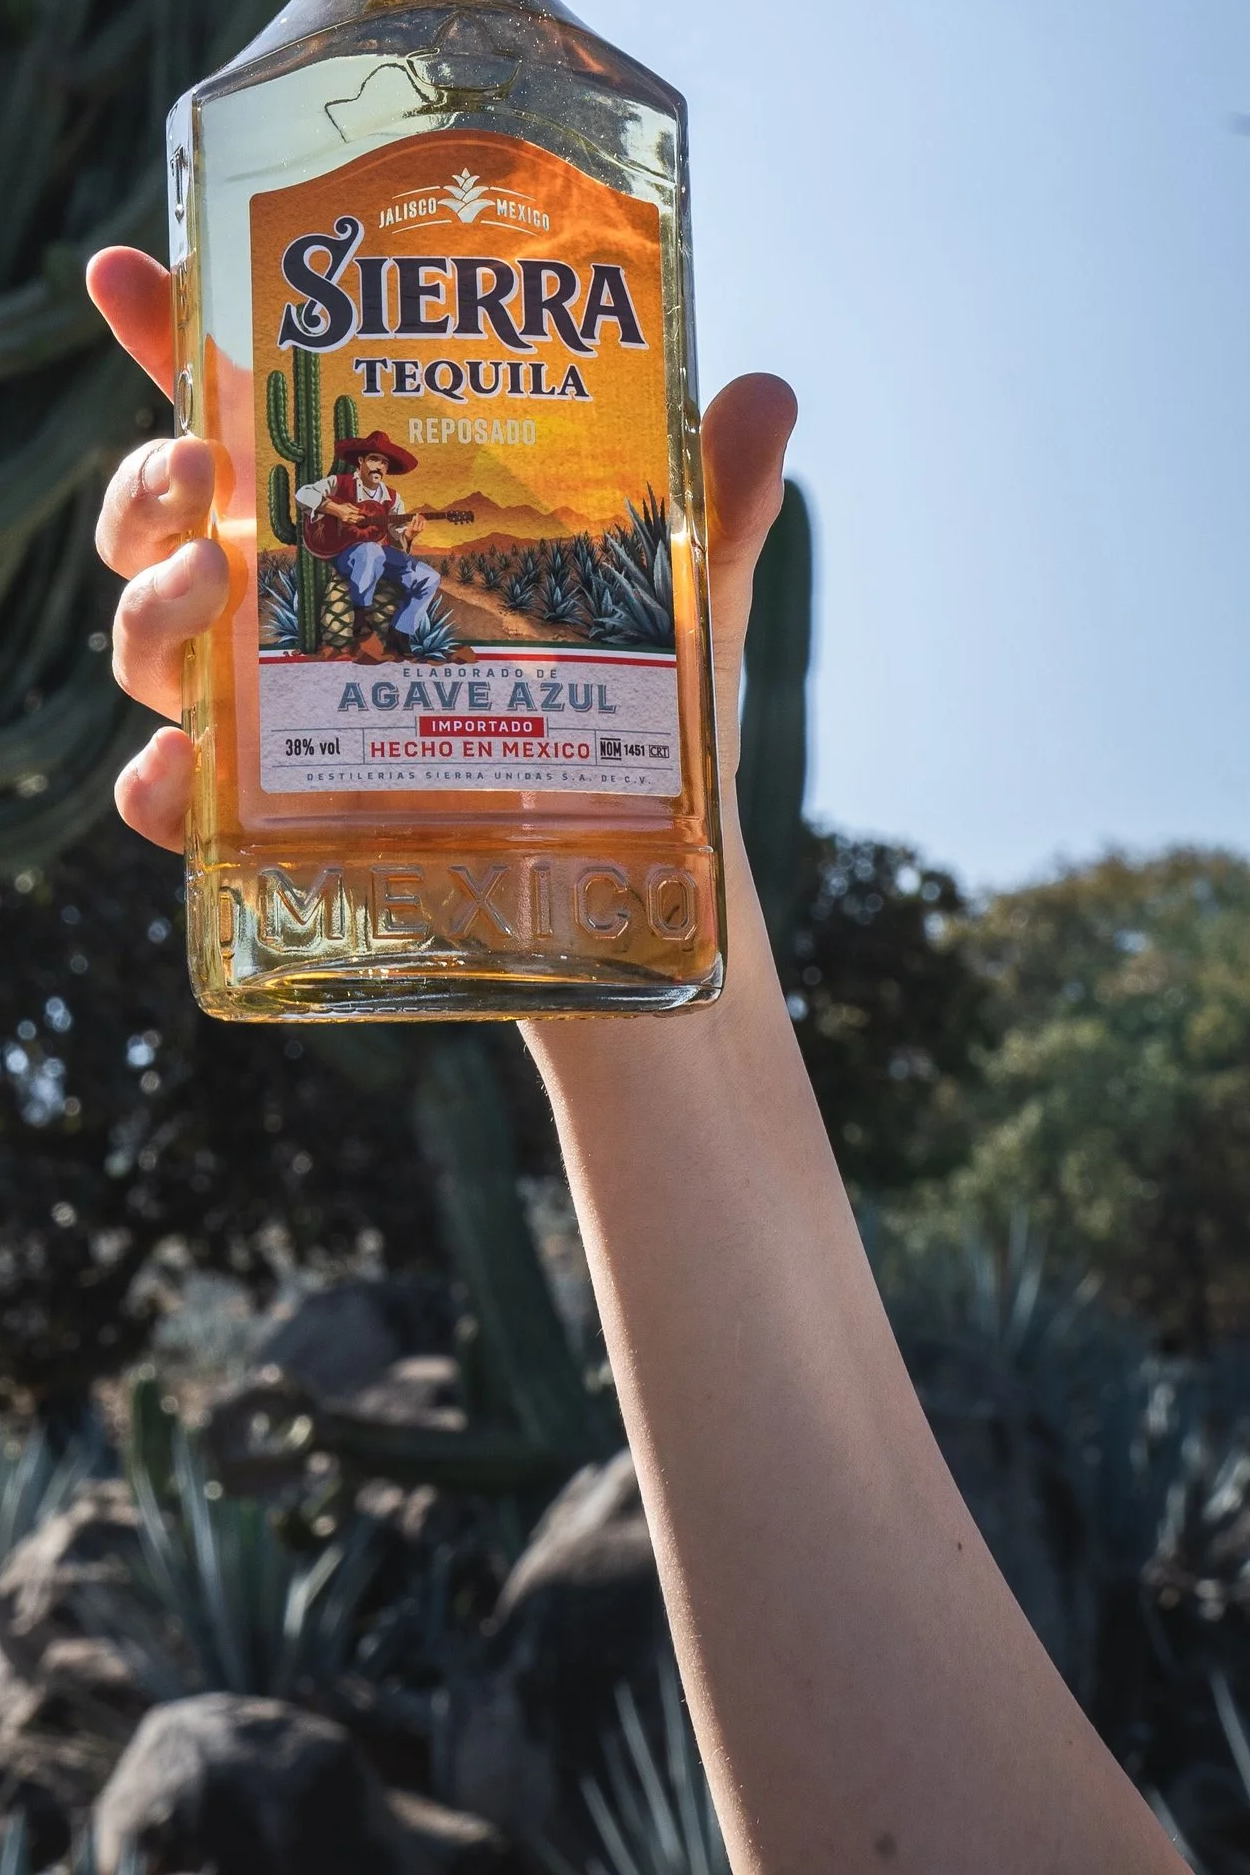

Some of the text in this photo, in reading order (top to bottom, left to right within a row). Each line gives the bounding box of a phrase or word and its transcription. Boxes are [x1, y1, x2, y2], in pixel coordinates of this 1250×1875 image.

[379, 198, 549, 230] JALISCO MEXICO
[277, 215, 649, 357] SIERRA
[354, 357, 593, 404] TEQUILA
[408, 417, 537, 445] REPOSADO
[403, 668, 557, 678] ELABORADO DE
[337, 681, 616, 713] AGAVE AZUL
[432, 720, 533, 732] IMPORTADO
[285, 738, 340, 755] 38% vol
[370, 741, 590, 759] HECHO EN MEXICO
[600, 741, 669, 758] NOM 1451 CRT
[307, 772, 416, 781] DESTILERIAS
[426, 772, 485, 781] SIERRA
[494, 773, 552, 781] UNIDAS
[259, 866, 698, 941] MEXICO
